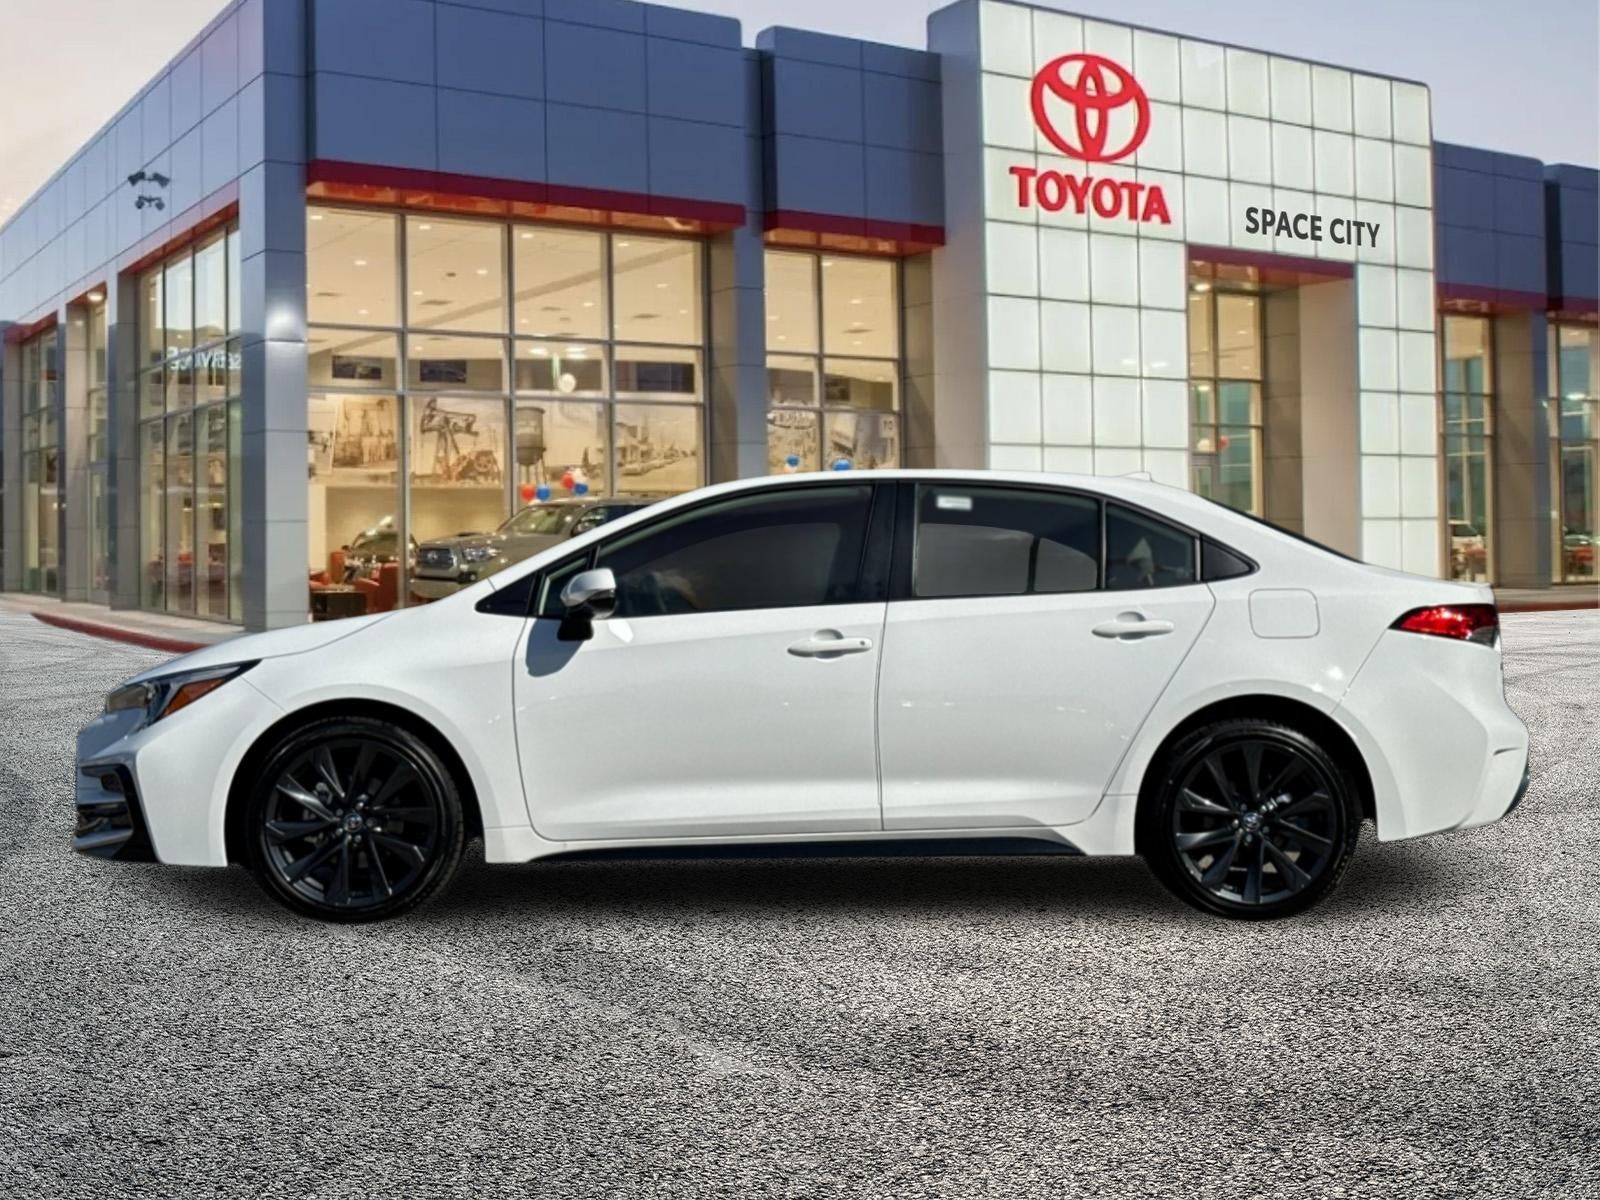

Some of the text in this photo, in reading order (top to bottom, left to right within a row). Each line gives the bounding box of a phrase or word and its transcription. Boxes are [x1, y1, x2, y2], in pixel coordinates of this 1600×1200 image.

[1009, 166, 1171, 224] TOYOTA
[1245, 206, 1380, 247] SPACE CITY
